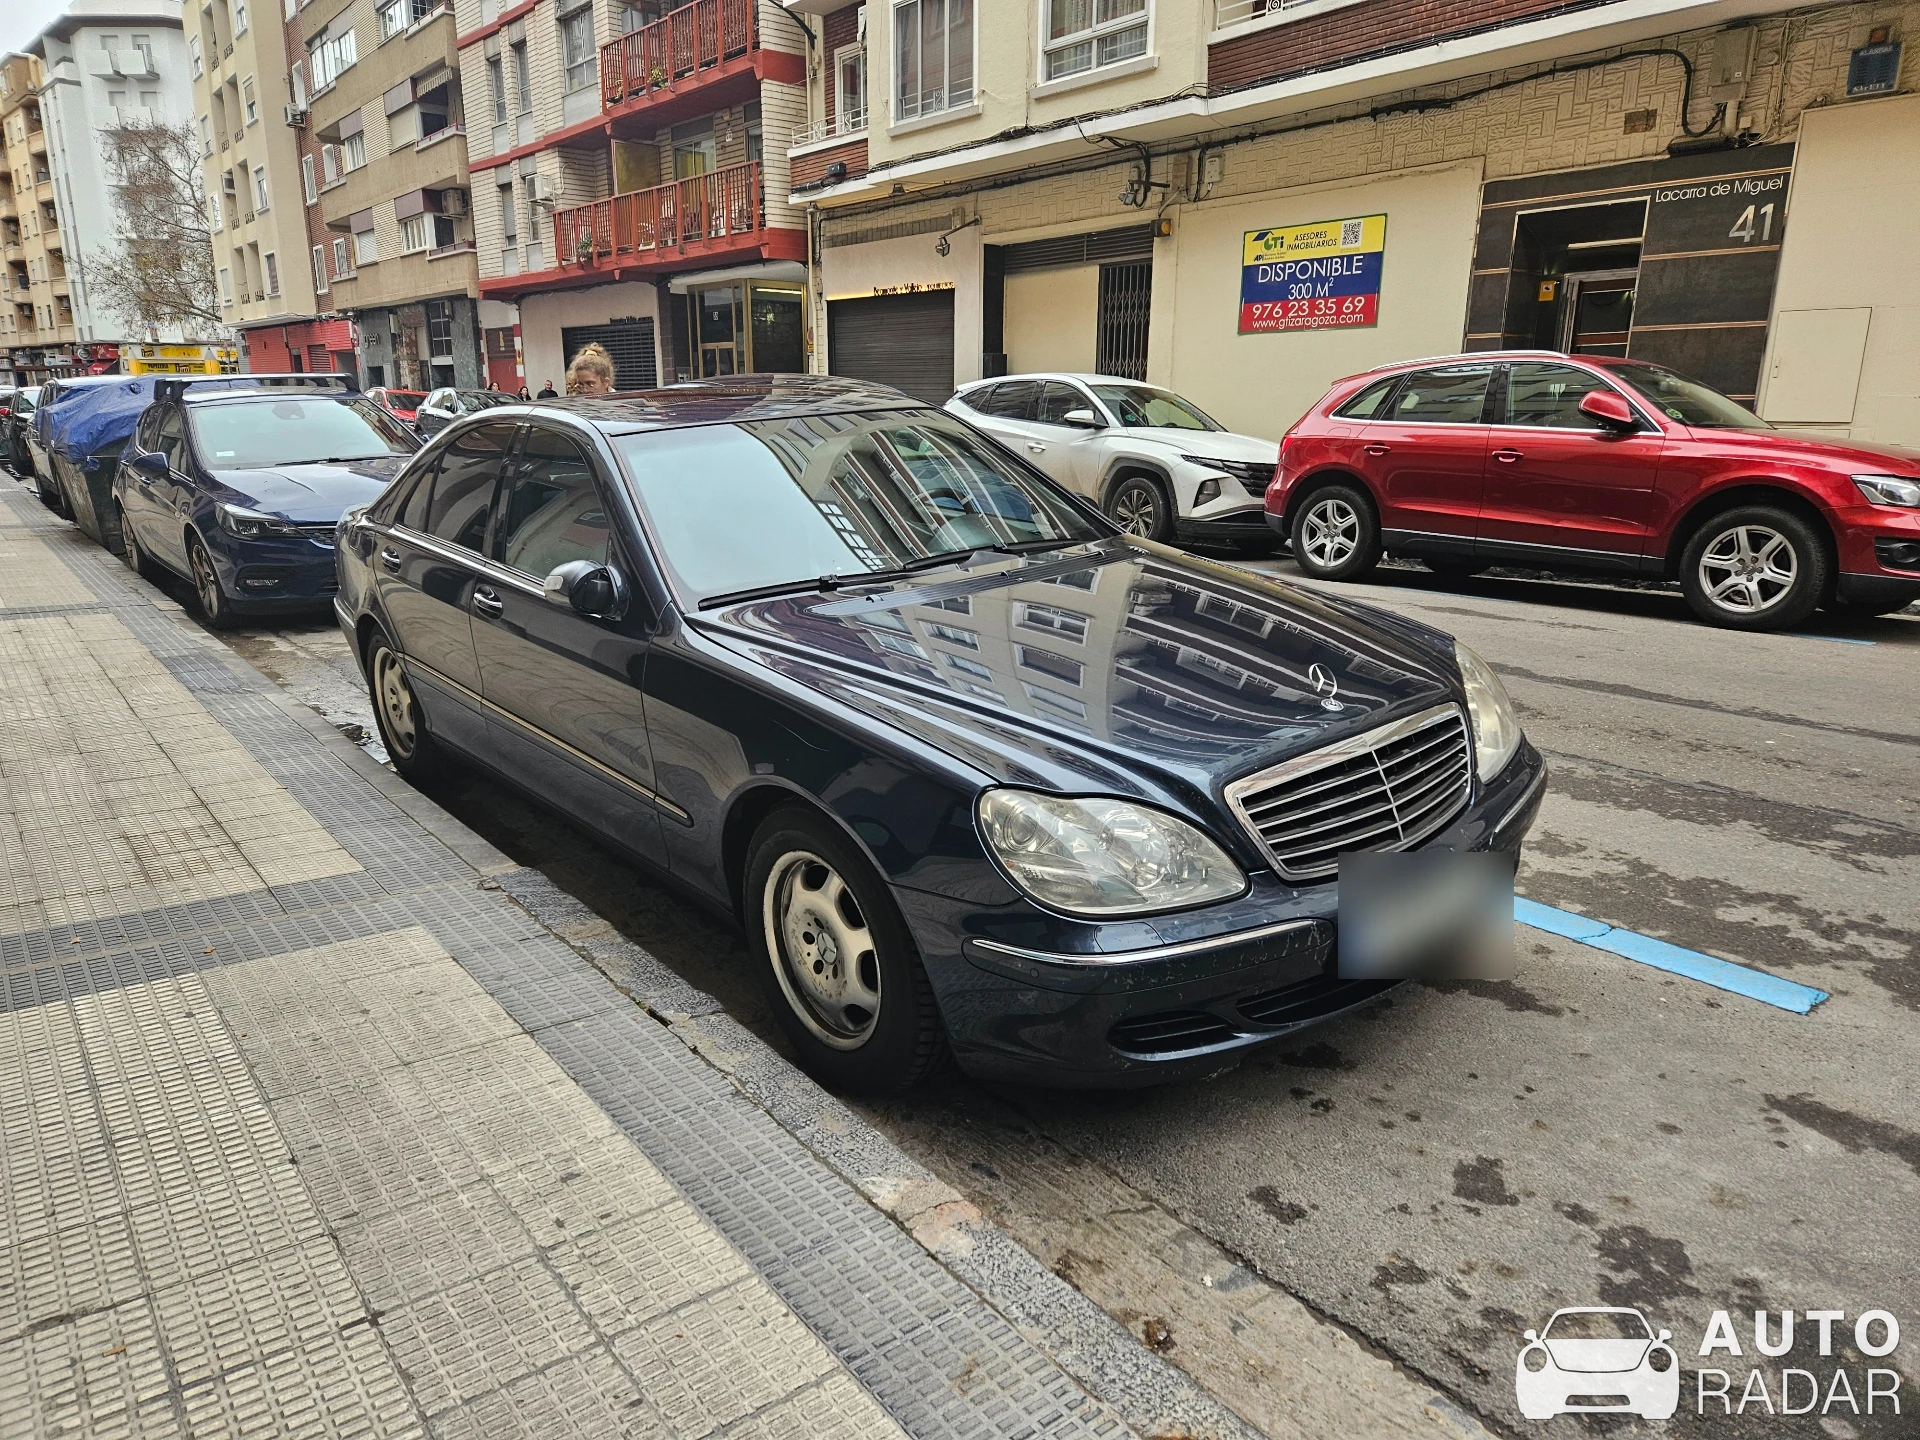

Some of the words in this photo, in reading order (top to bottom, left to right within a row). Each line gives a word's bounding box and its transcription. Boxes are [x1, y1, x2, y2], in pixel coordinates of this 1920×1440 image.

[1655, 186, 1707, 203] Lacarra
[1709, 183, 1731, 196] de
[1733, 175, 1784, 196] Miguel
[1728, 203, 1775, 243] 41
[1286, 238, 1338, 251] INMOBILIARIOS
[1294, 230, 1328, 242] ASESORES
[1258, 255, 1364, 283] DISPONIBLE
[1288, 282, 1312, 300] 300
[1252, 303, 1283, 319] 976
[1288, 301, 1309, 316] 23
[1315, 298, 1337, 314] 35
[1342, 296, 1365, 313] 69
[1252, 312, 1364, 330] www.gtizaragoza.com
